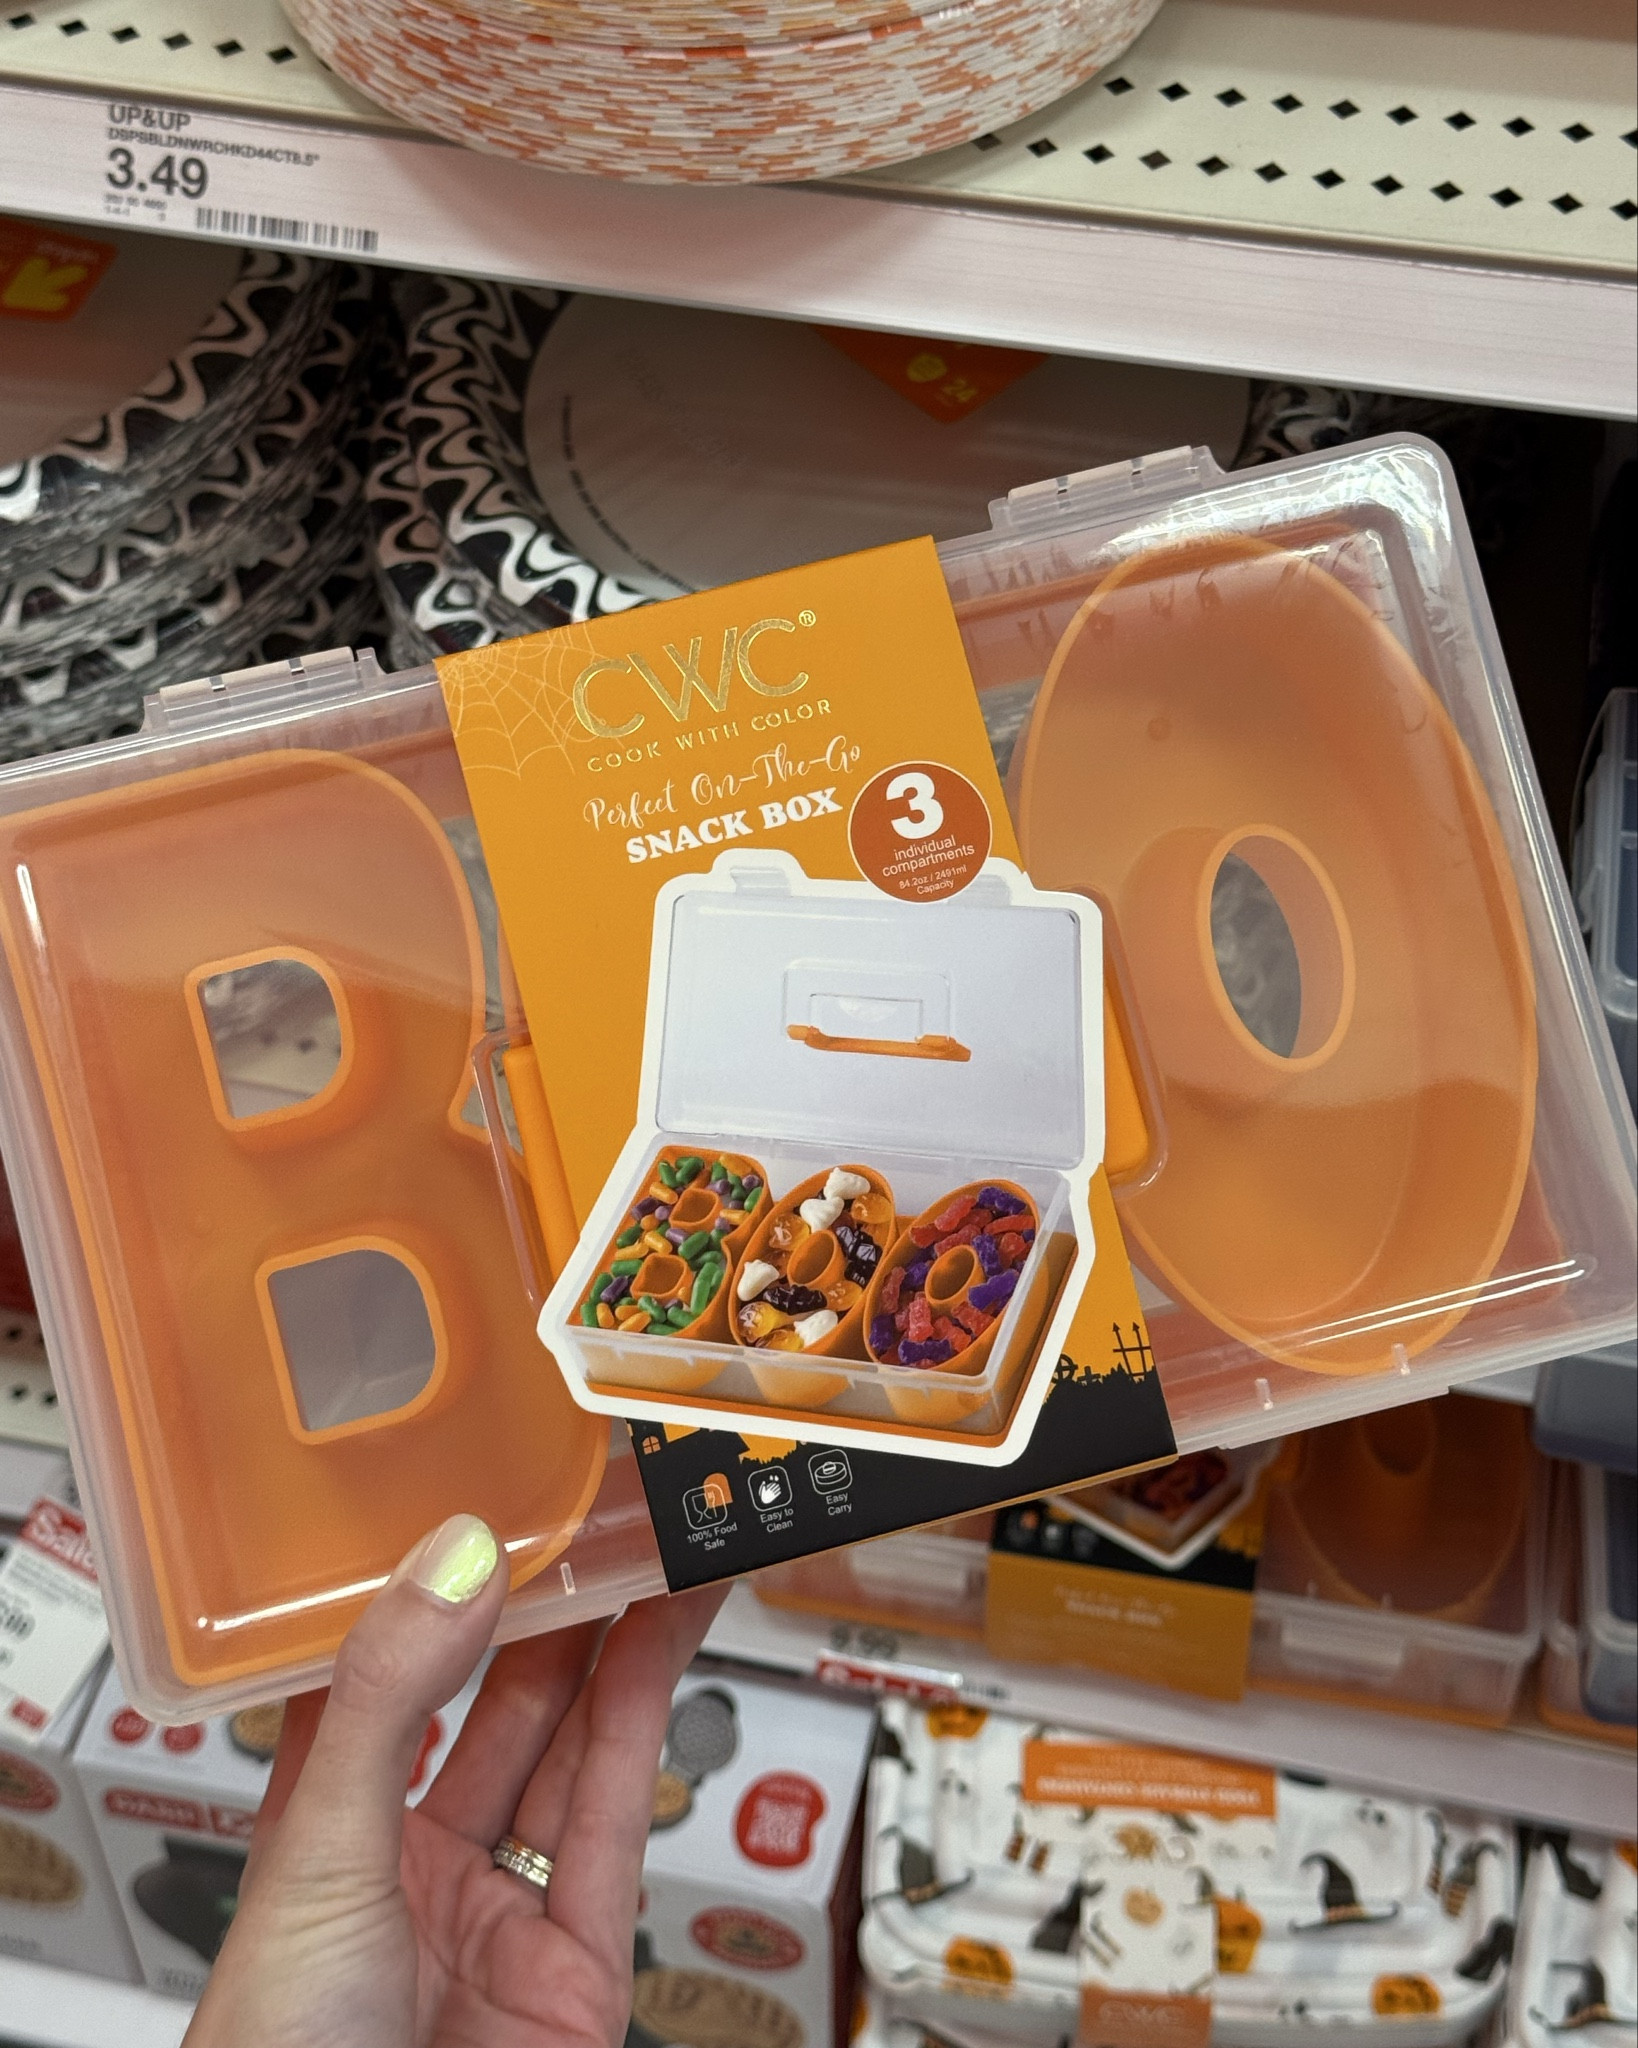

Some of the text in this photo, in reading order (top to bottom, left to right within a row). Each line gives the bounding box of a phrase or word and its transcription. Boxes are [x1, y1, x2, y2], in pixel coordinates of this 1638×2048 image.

[108, 104, 191, 132] UP&UP
[107, 147, 208, 200] 3.49
[587, 698, 832, 772] COOK WITH COLOR
[583, 778, 678, 831] Perfect
[886, 772, 944, 839] 3
[626, 786, 844, 863] SNACK BOX
[882, 845, 975, 877] compartments
[893, 835, 957, 861] individual
[917, 879, 954, 895] Capacity
[826, 1492, 849, 1505] Easy
[827, 1503, 853, 1517] Carry
[760, 1507, 794, 1524] Easy to
[766, 1520, 794, 1534] Clean
[687, 1522, 738, 1544] 100% Food
[704, 1538, 726, 1552] Safe
